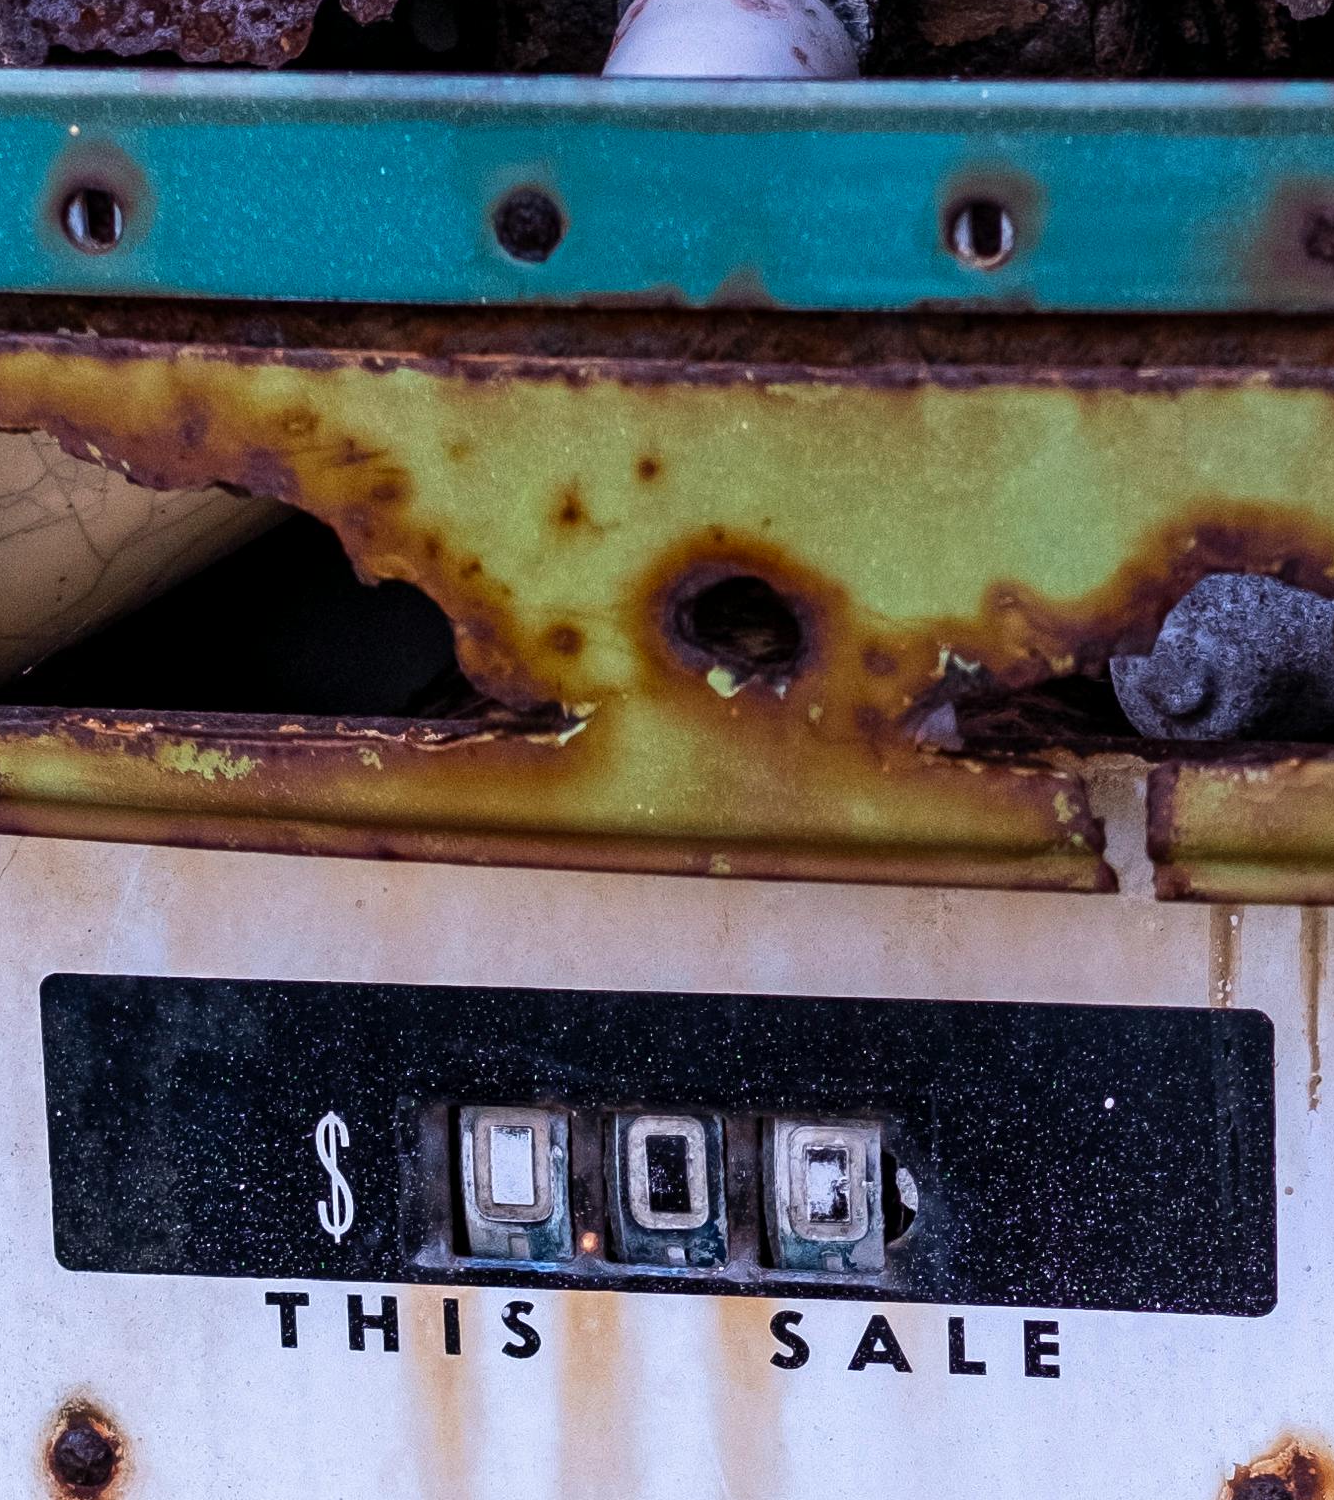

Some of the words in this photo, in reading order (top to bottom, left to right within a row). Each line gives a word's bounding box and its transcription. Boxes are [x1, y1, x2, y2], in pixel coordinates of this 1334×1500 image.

[315, 1110, 354, 1243] $
[265, 1292, 541, 1358] THIS
[770, 1311, 1060, 1380] SALE
